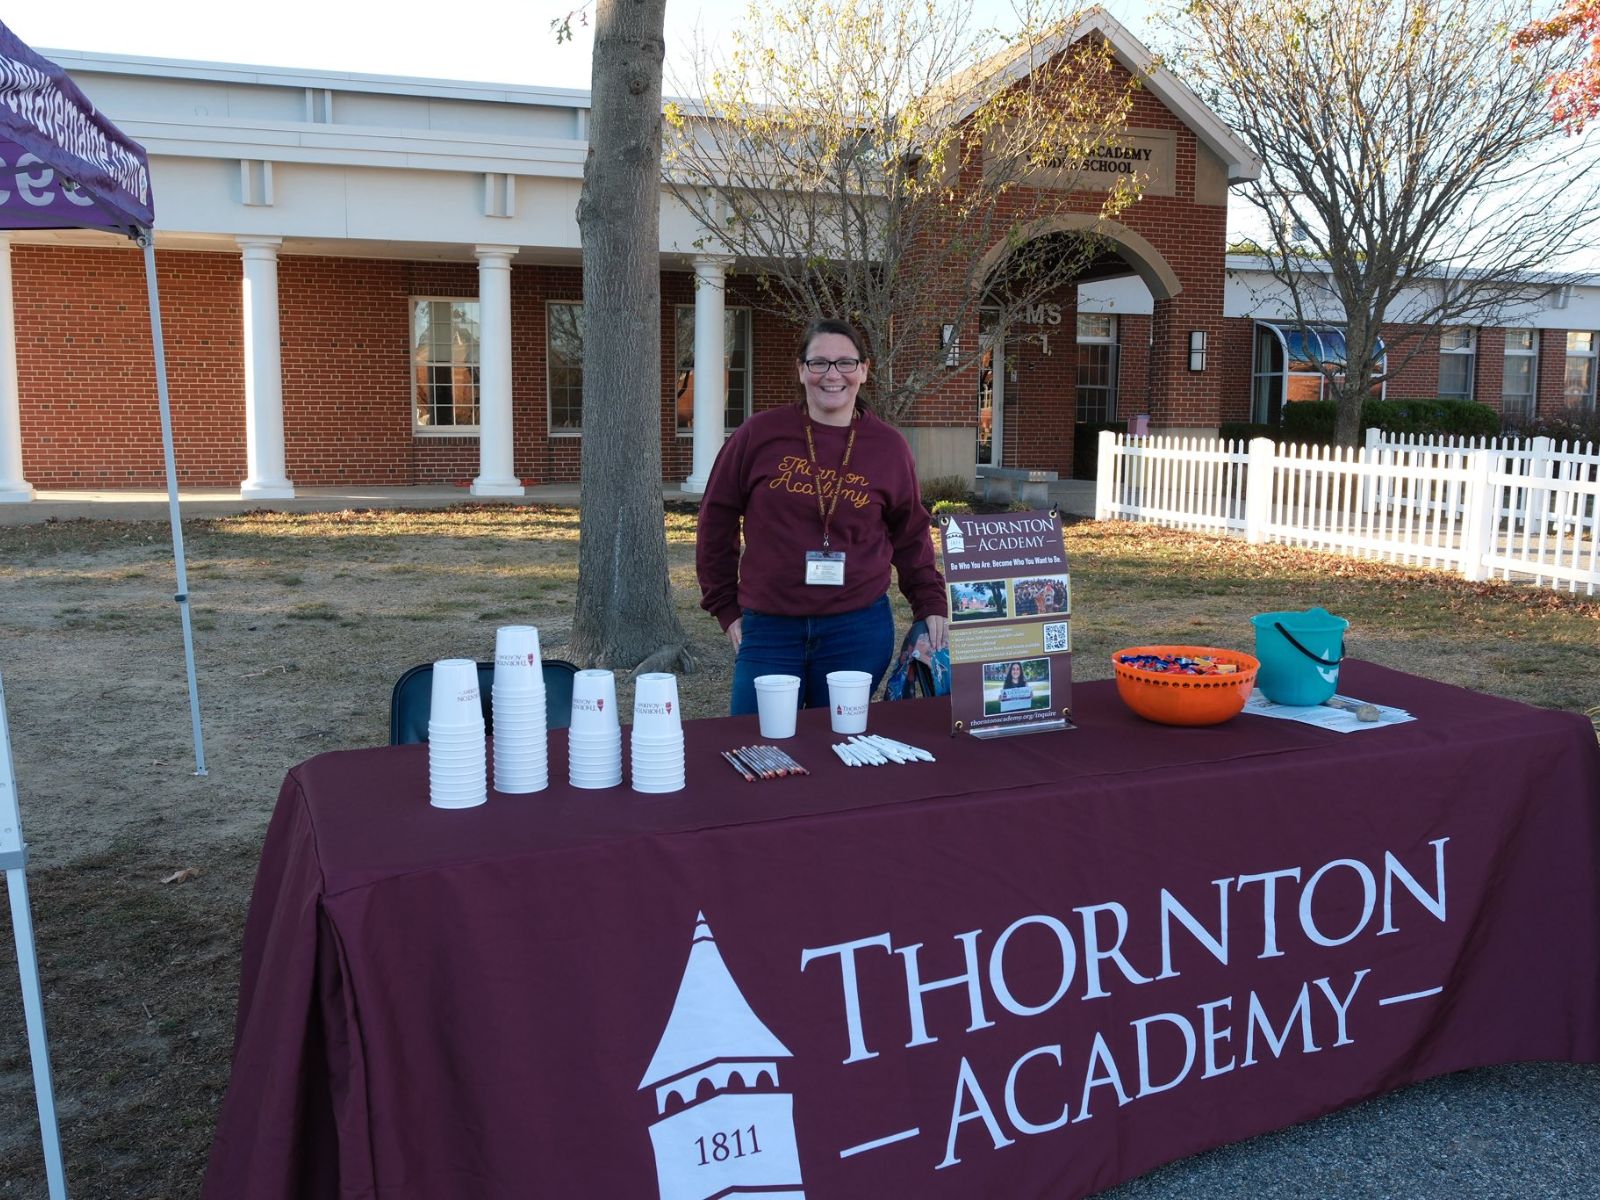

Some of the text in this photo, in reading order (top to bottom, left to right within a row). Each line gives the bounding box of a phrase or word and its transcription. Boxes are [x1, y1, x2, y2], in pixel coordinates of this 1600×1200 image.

[1082, 160, 1135, 174] SCHOOL
[778, 456, 869, 486] Thrnon
[962, 518, 1054, 536] THORNTON
[978, 536, 1045, 552] ACADEMY
[950, 562, 958, 571] Be
[959, 561, 971, 570] Who
[971, 561, 980, 569] You
[981, 560, 992, 569] Are.
[992, 559, 1013, 568] Become
[1013, 558, 1024, 567] Who
[1024, 557, 1034, 566] You
[1034, 556, 1047, 565] Want
[1053, 555, 1062, 563] Be.
[800, 837, 1450, 1064] THORNTON
[935, 968, 1371, 1170] ACADEMY
[694, 1124, 763, 1167] 1811
